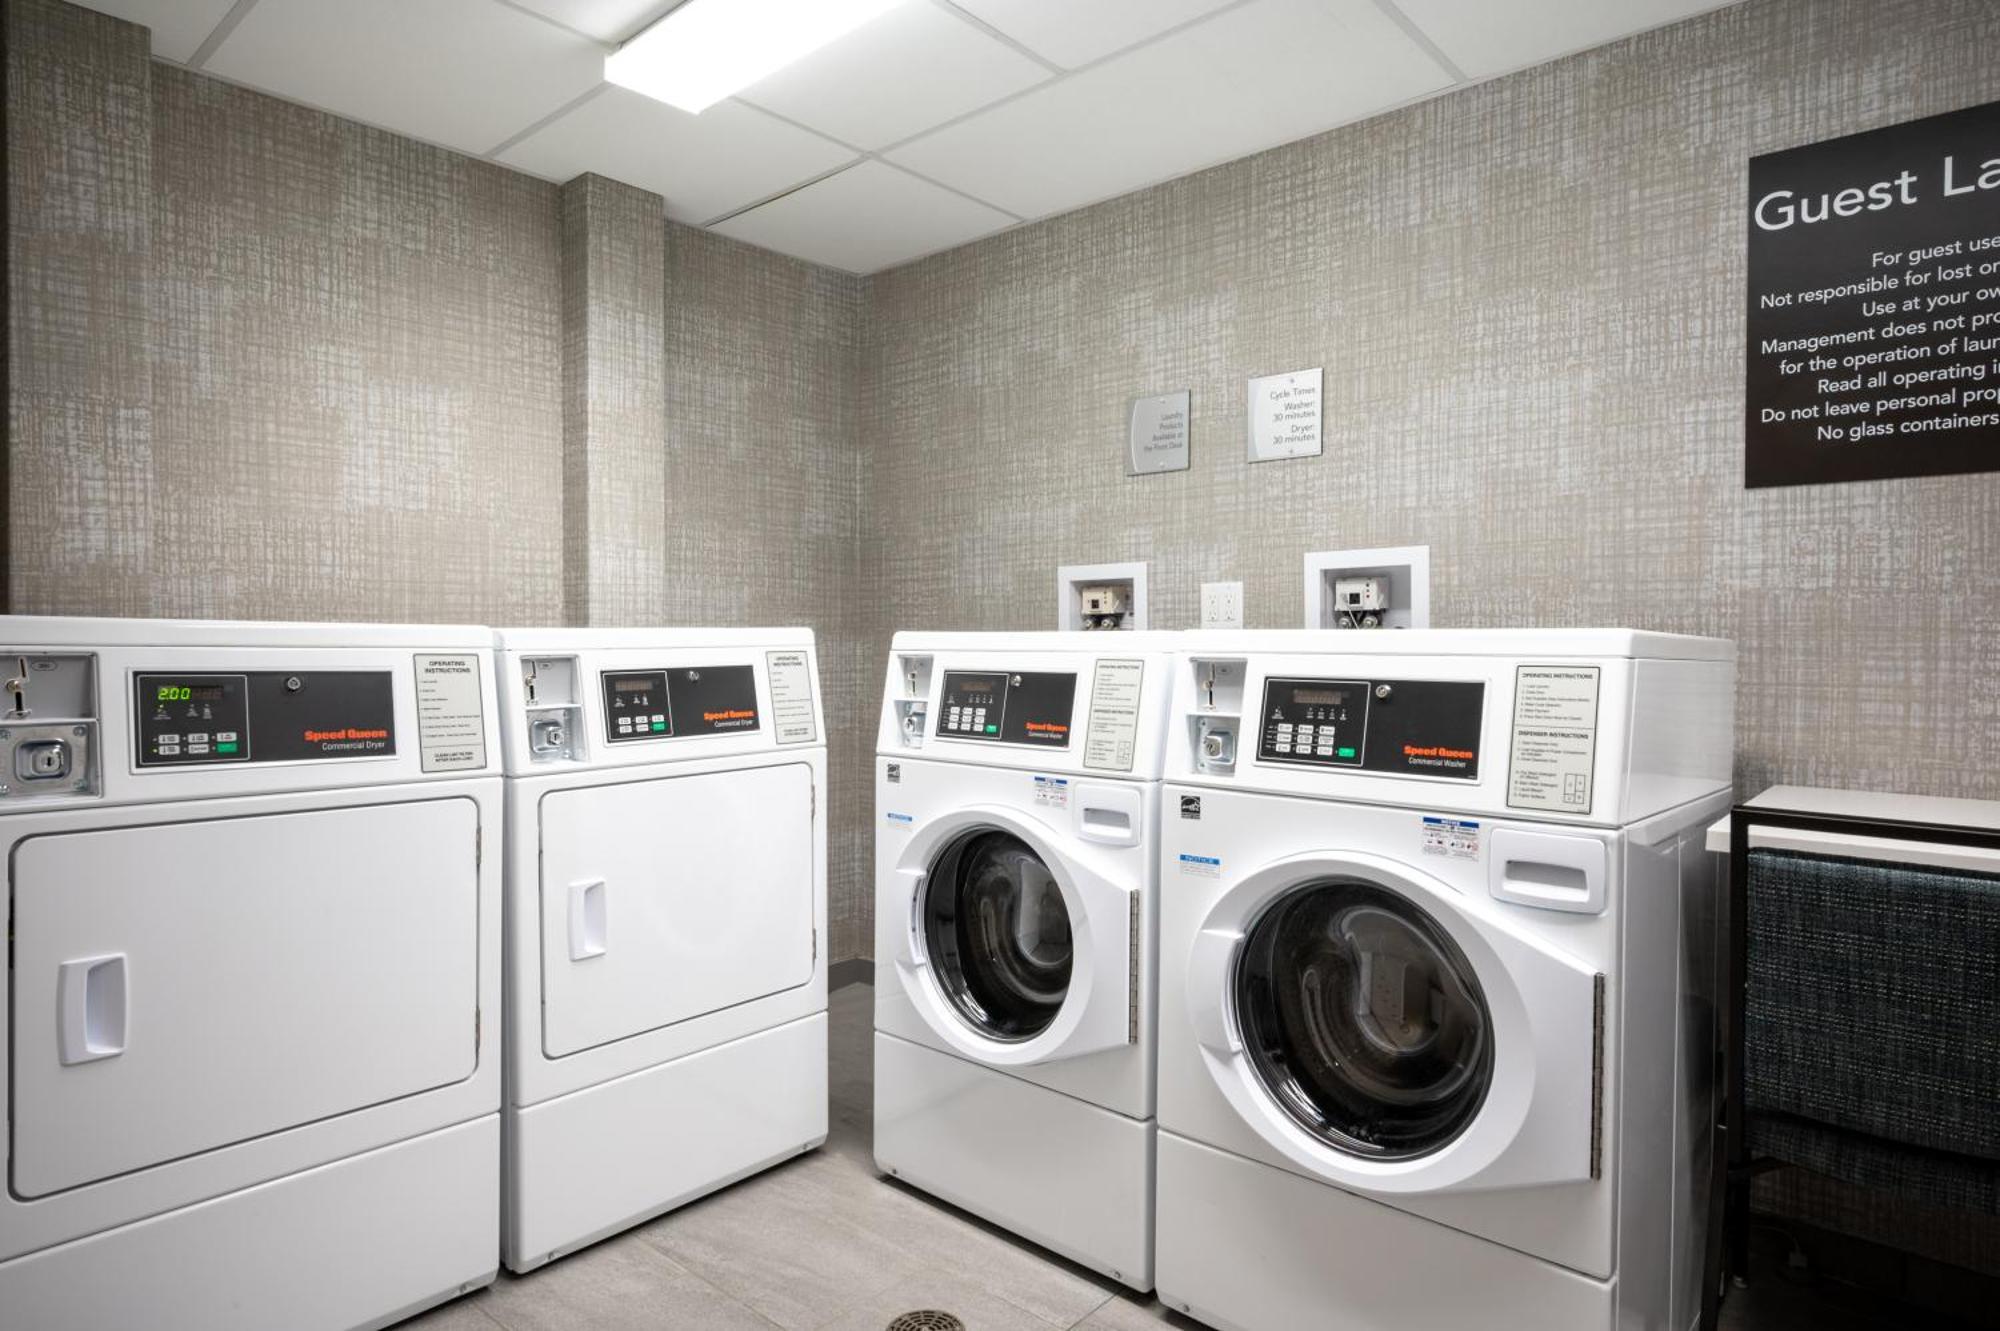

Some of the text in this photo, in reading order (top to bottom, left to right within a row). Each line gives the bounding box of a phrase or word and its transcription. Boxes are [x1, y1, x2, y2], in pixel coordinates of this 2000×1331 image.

[1754, 170, 1918, 231] Guest
[1871, 251, 1903, 268] For
[1908, 240, 1963, 267] guest
[1760, 292, 1793, 309] Not
[1798, 273, 1899, 305] responsible
[1903, 269, 1932, 287] for
[1938, 264, 1973, 282] lost
[1862, 300, 1897, 317] Use
[1902, 295, 1921, 312] at
[1926, 290, 1970, 313] your
[1761, 327, 1876, 355] Management
[1881, 321, 1928, 339] does
[1932, 314, 1966, 332] not
[1779, 359, 1805, 375] for
[1808, 355, 1837, 372] the
[1843, 344, 1931, 371] operation
[1937, 336, 1958, 356] of
[1817, 373, 1862, 394] Read
[1867, 371, 1887, 389] all
[1892, 362, 1986, 390] operating
[1285, 409, 1316, 421] minutes
[1761, 407, 1786, 424] Do
[1791, 404, 1820, 420] not
[1824, 400, 1871, 417] leave
[1876, 386, 1957, 417] personal
[1285, 433, 1316, 443] minutes
[1291, 424, 1313, 434] Dryer
[1817, 412, 2000, 442] No glass containers
[304, 728, 387, 742] Speed Queen
[322, 740, 386, 751] Commercial Dryer
[1404, 745, 1473, 759] Speed Queen
[1408, 756, 1467, 768] Commercial Washer
